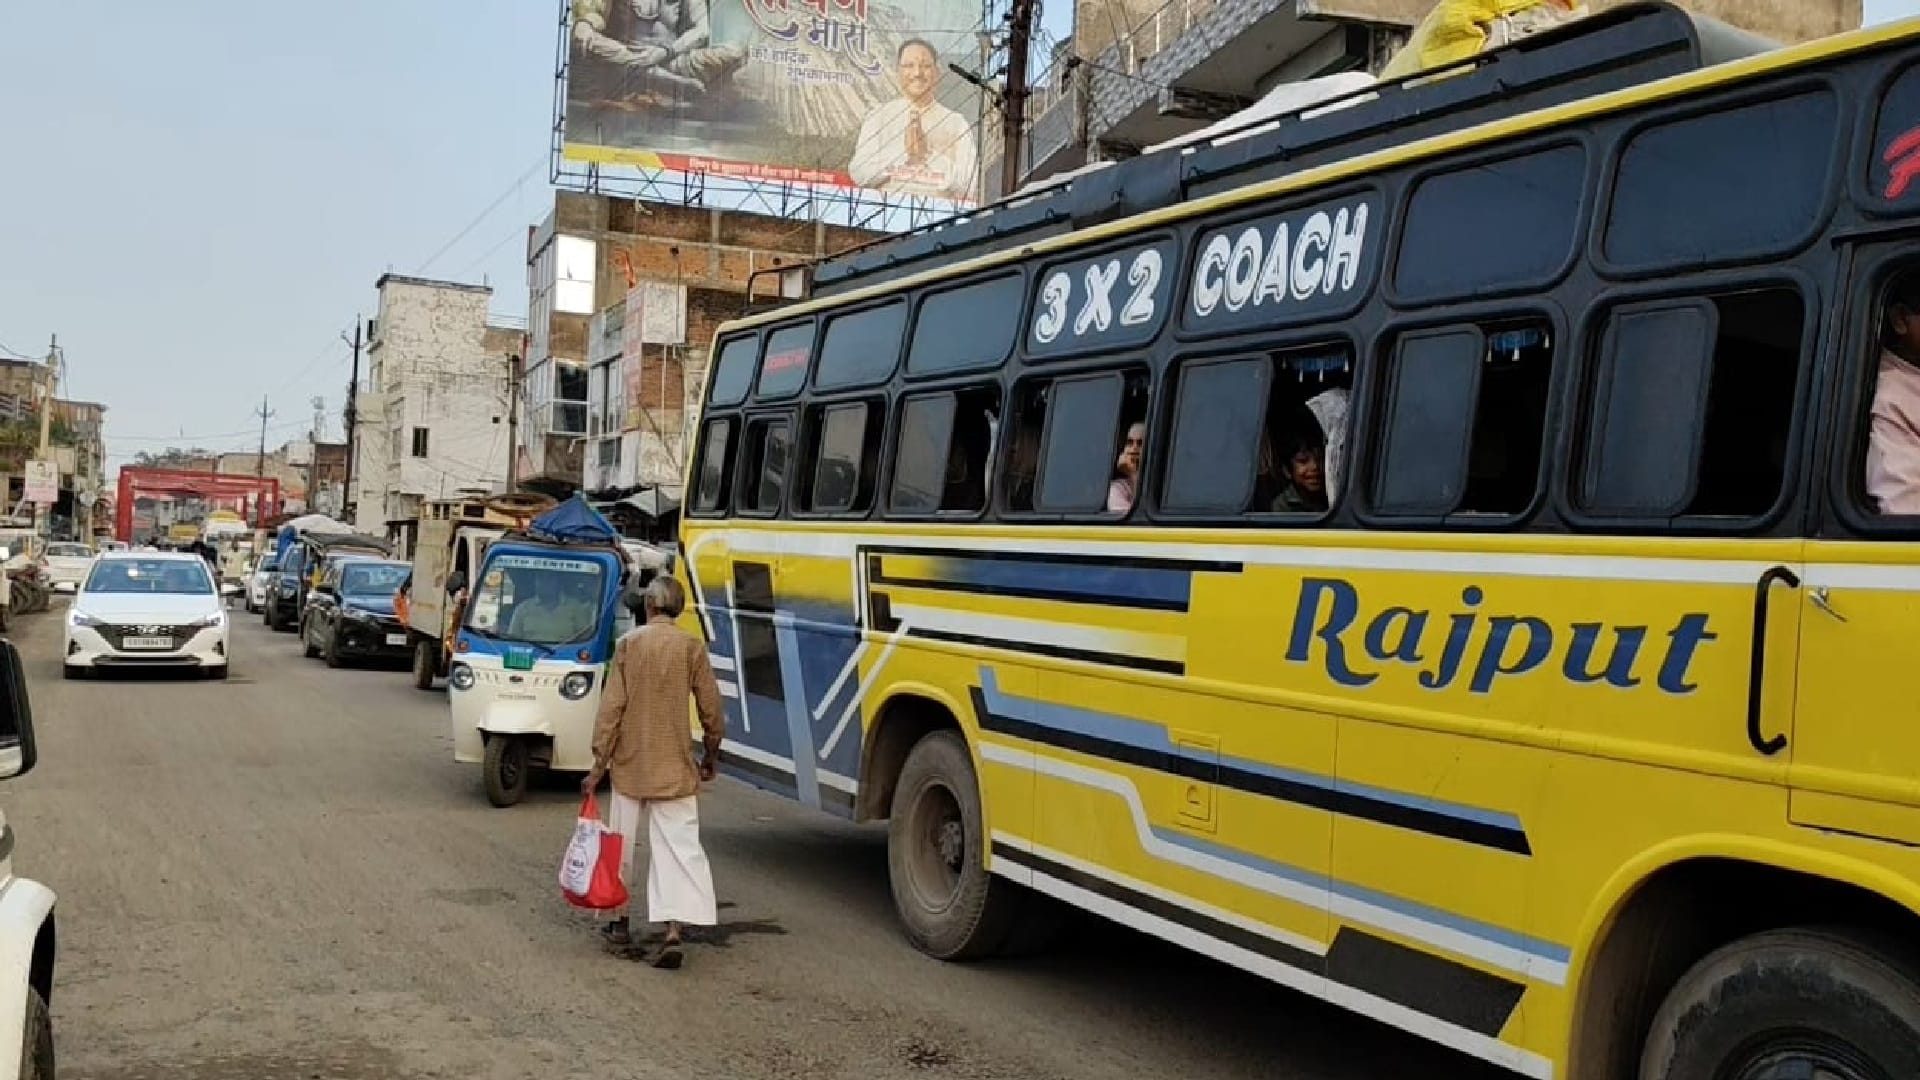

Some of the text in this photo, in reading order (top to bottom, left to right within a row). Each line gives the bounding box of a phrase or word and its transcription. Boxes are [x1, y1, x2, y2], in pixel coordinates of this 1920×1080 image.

[807, 17, 882, 76] मास
[1034, 202, 1368, 343] 3 X 2 COACH
[533, 560, 581, 569] CENTRE
[1284, 576, 1718, 694] Rajput
